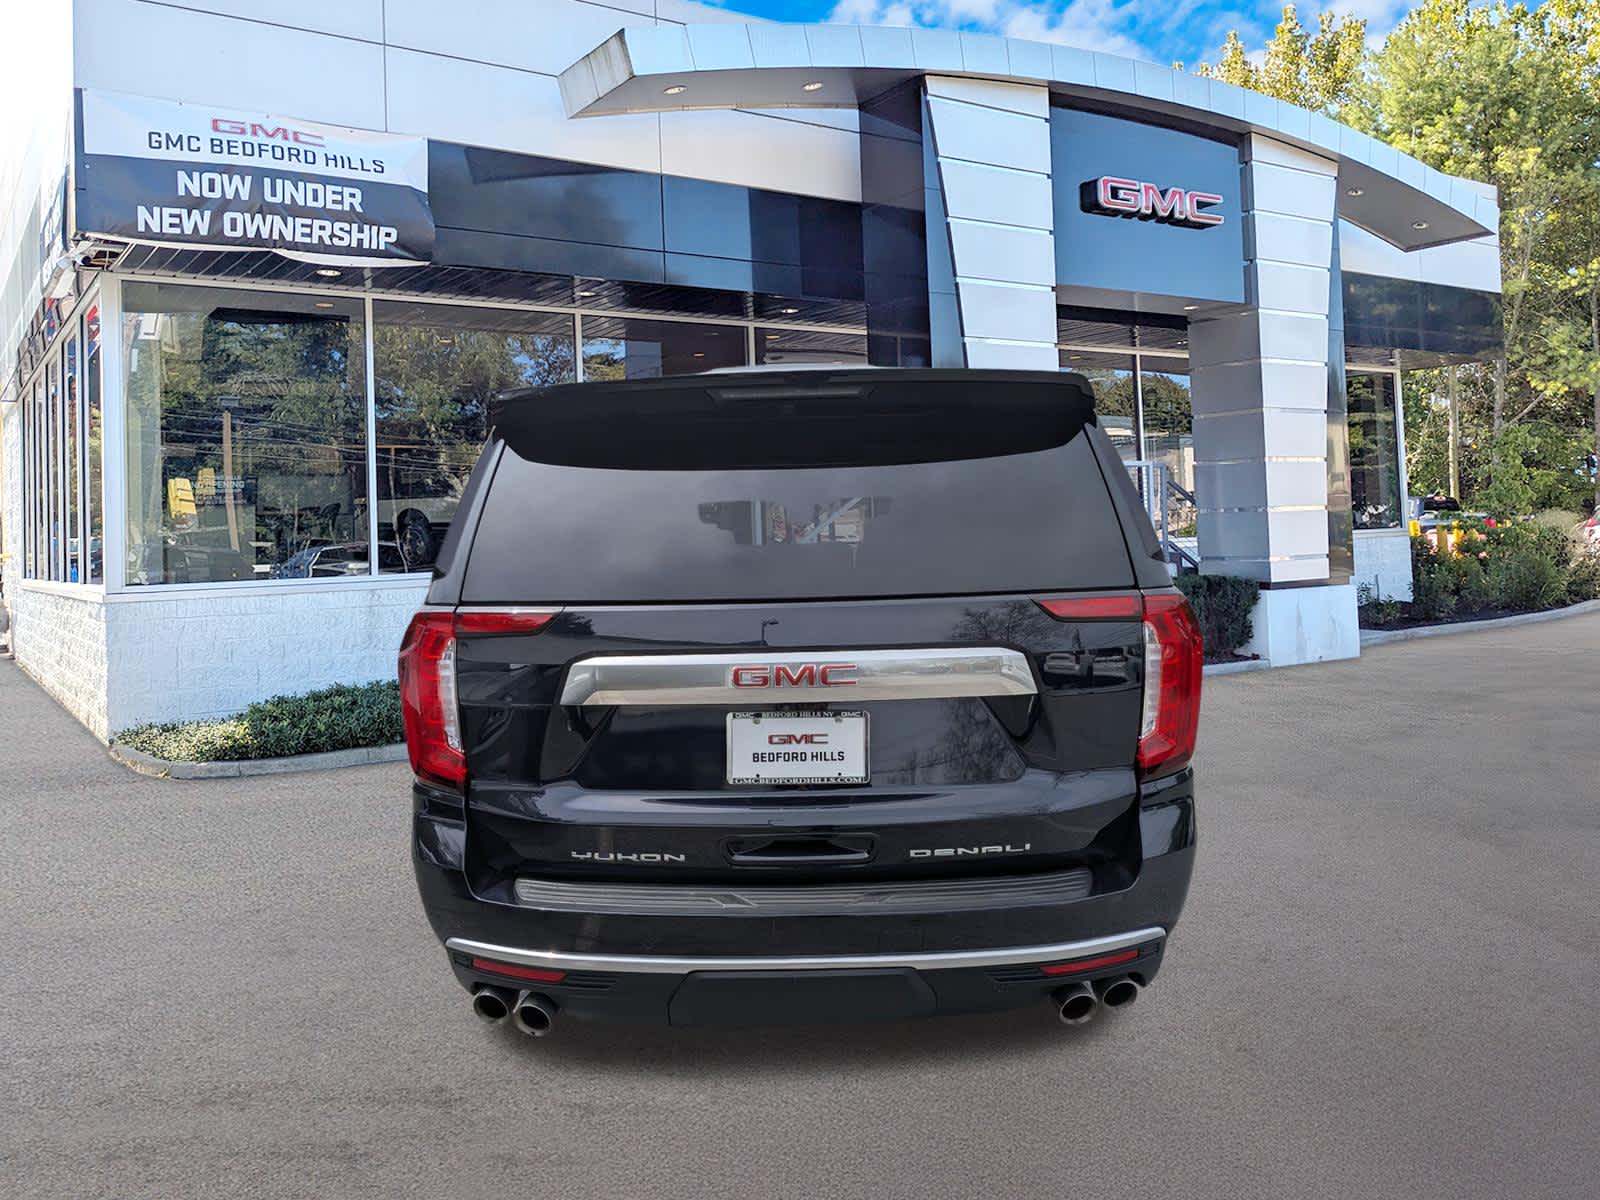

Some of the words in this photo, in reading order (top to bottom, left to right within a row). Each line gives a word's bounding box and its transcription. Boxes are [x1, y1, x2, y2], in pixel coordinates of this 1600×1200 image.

[211, 118, 325, 148] GMC
[148, 131, 200, 152] GMC
[210, 138, 316, 165] BEDFORD
[325, 154, 385, 174] HILLS
[177, 170, 252, 200] NOW
[263, 177, 364, 213] UNDER
[1097, 175, 1225, 225] GMC
[136, 205, 211, 236] NEW
[223, 211, 398, 250] OWNERSHIP
[732, 663, 857, 688] GMC
[762, 711, 797, 719] BEDFORD
[799, 711, 821, 719] HILLS
[768, 733, 829, 745] GMC
[752, 752, 807, 763] BEDFORD
[810, 751, 845, 762] HILLS
[571, 851, 685, 862] YUKON
[909, 843, 1031, 857] DENALI
